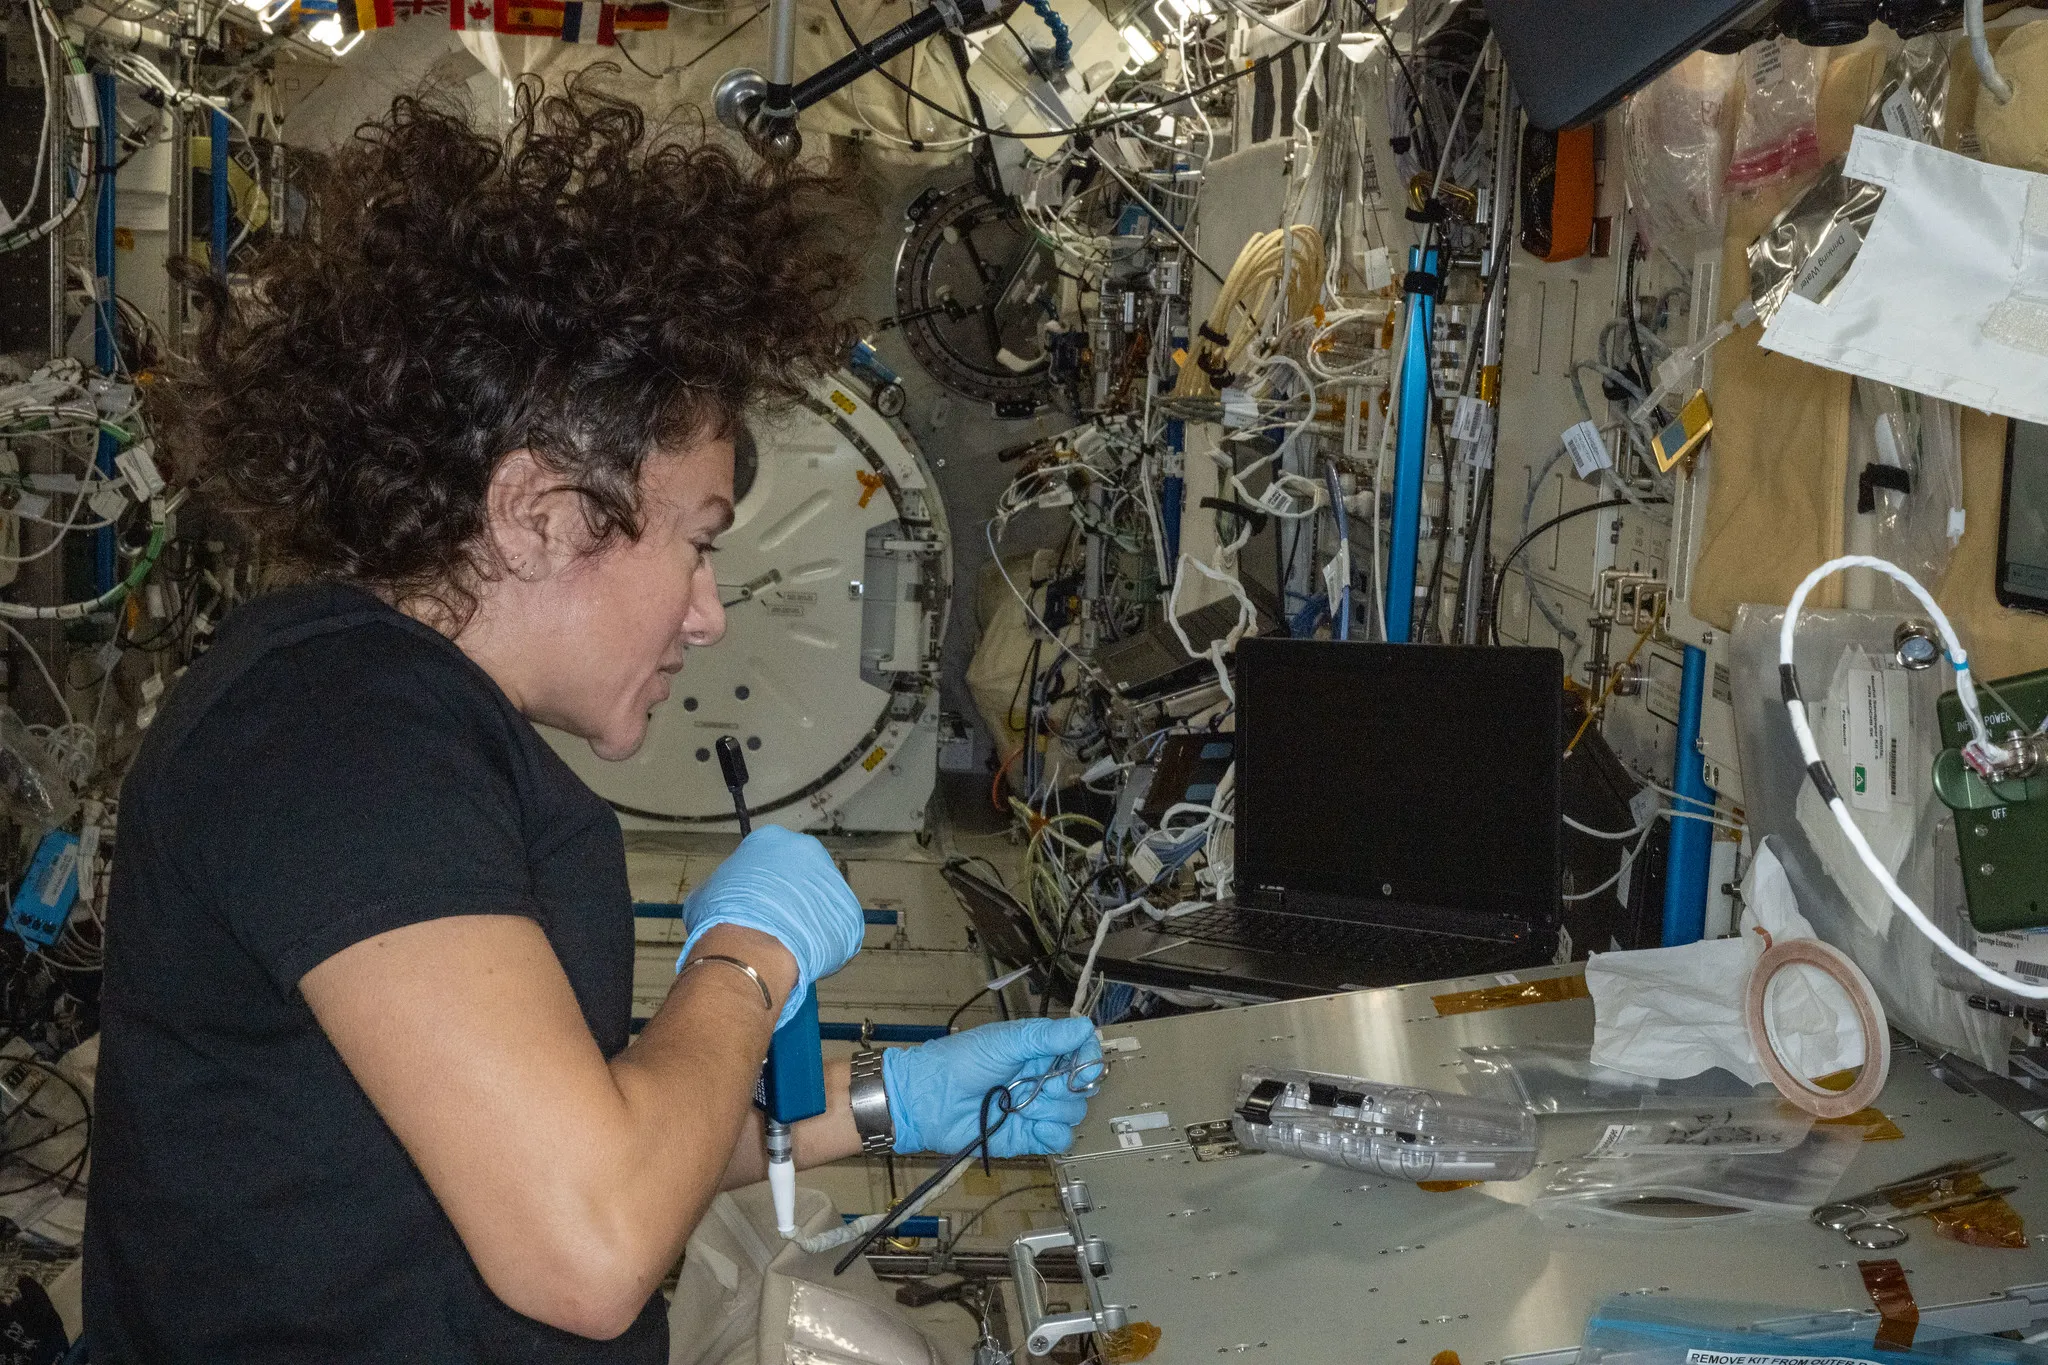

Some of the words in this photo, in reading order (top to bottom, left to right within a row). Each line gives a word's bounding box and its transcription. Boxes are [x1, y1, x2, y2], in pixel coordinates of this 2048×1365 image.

[1817, 235, 1845, 267] Drinking
[1801, 266, 1820, 290] Water
[1984, 712, 2011, 725] POWER
[1992, 807, 2007, 819] OFF
[1691, 1353, 1746, 1365] REMOVE
[1748, 1356, 1770, 1365] KIT
[1770, 1357, 1809, 1365] FROM
